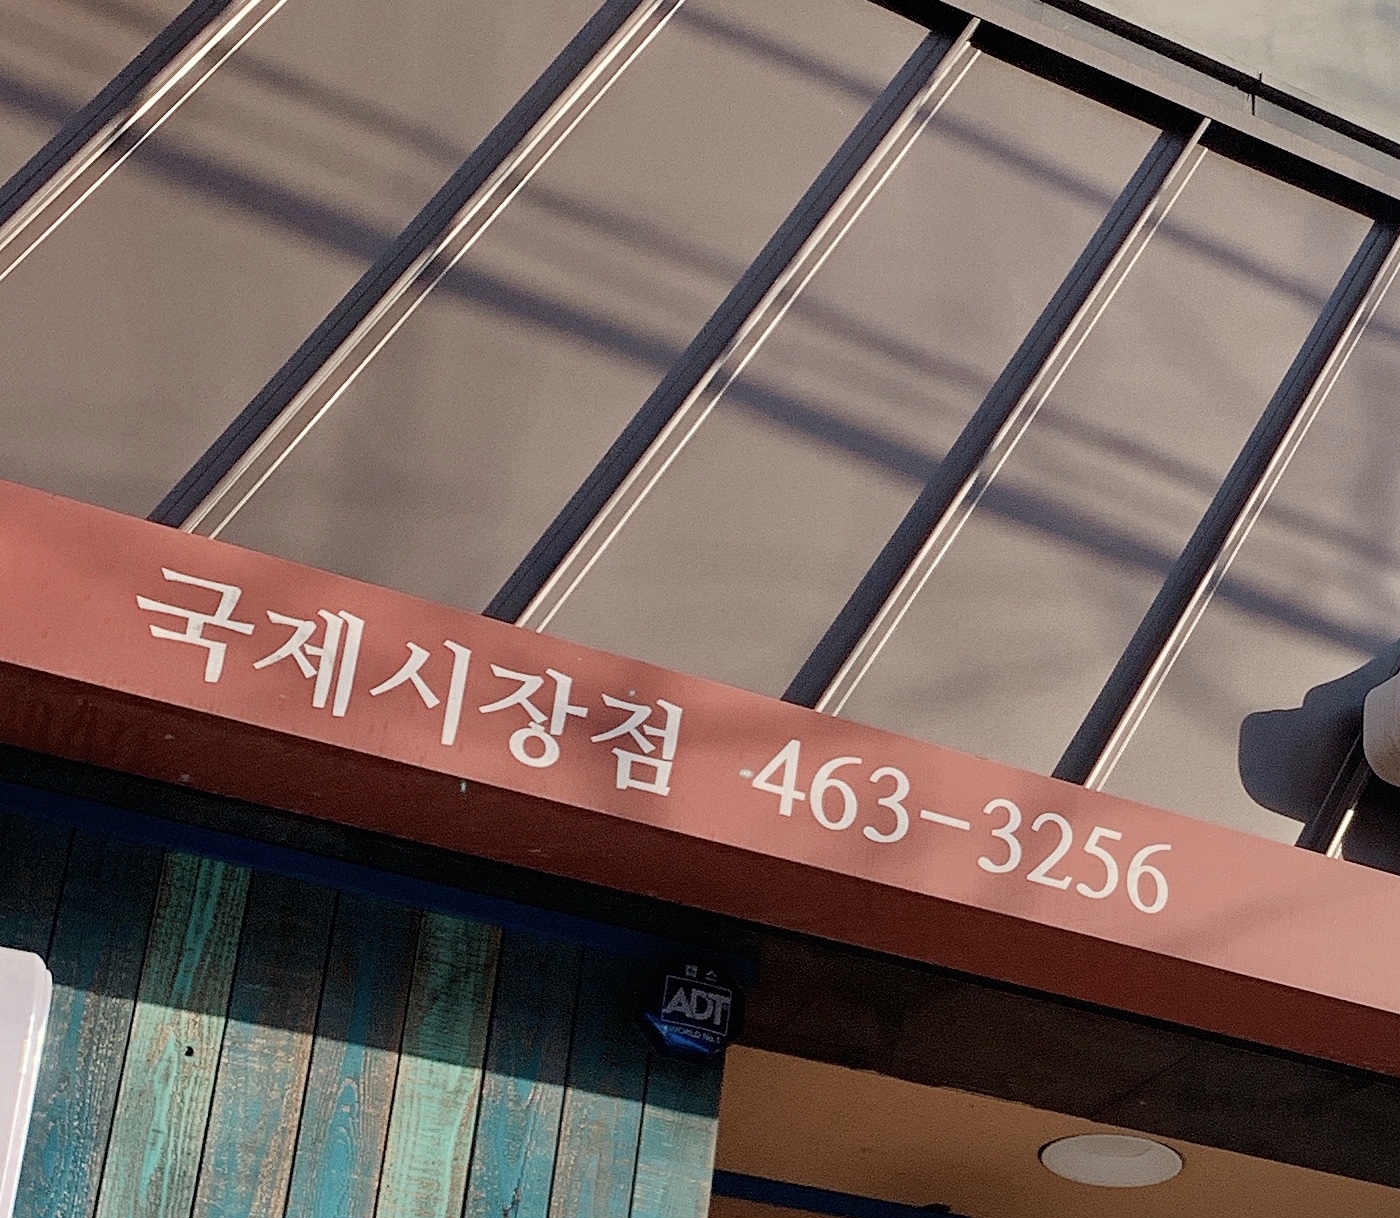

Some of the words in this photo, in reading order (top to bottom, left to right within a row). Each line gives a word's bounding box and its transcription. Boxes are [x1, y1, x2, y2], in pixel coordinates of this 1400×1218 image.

[135, 566, 684, 797] 국제시장점
[750, 738, 1173, 915] 463-3256
[661, 987, 732, 1026] ADT
